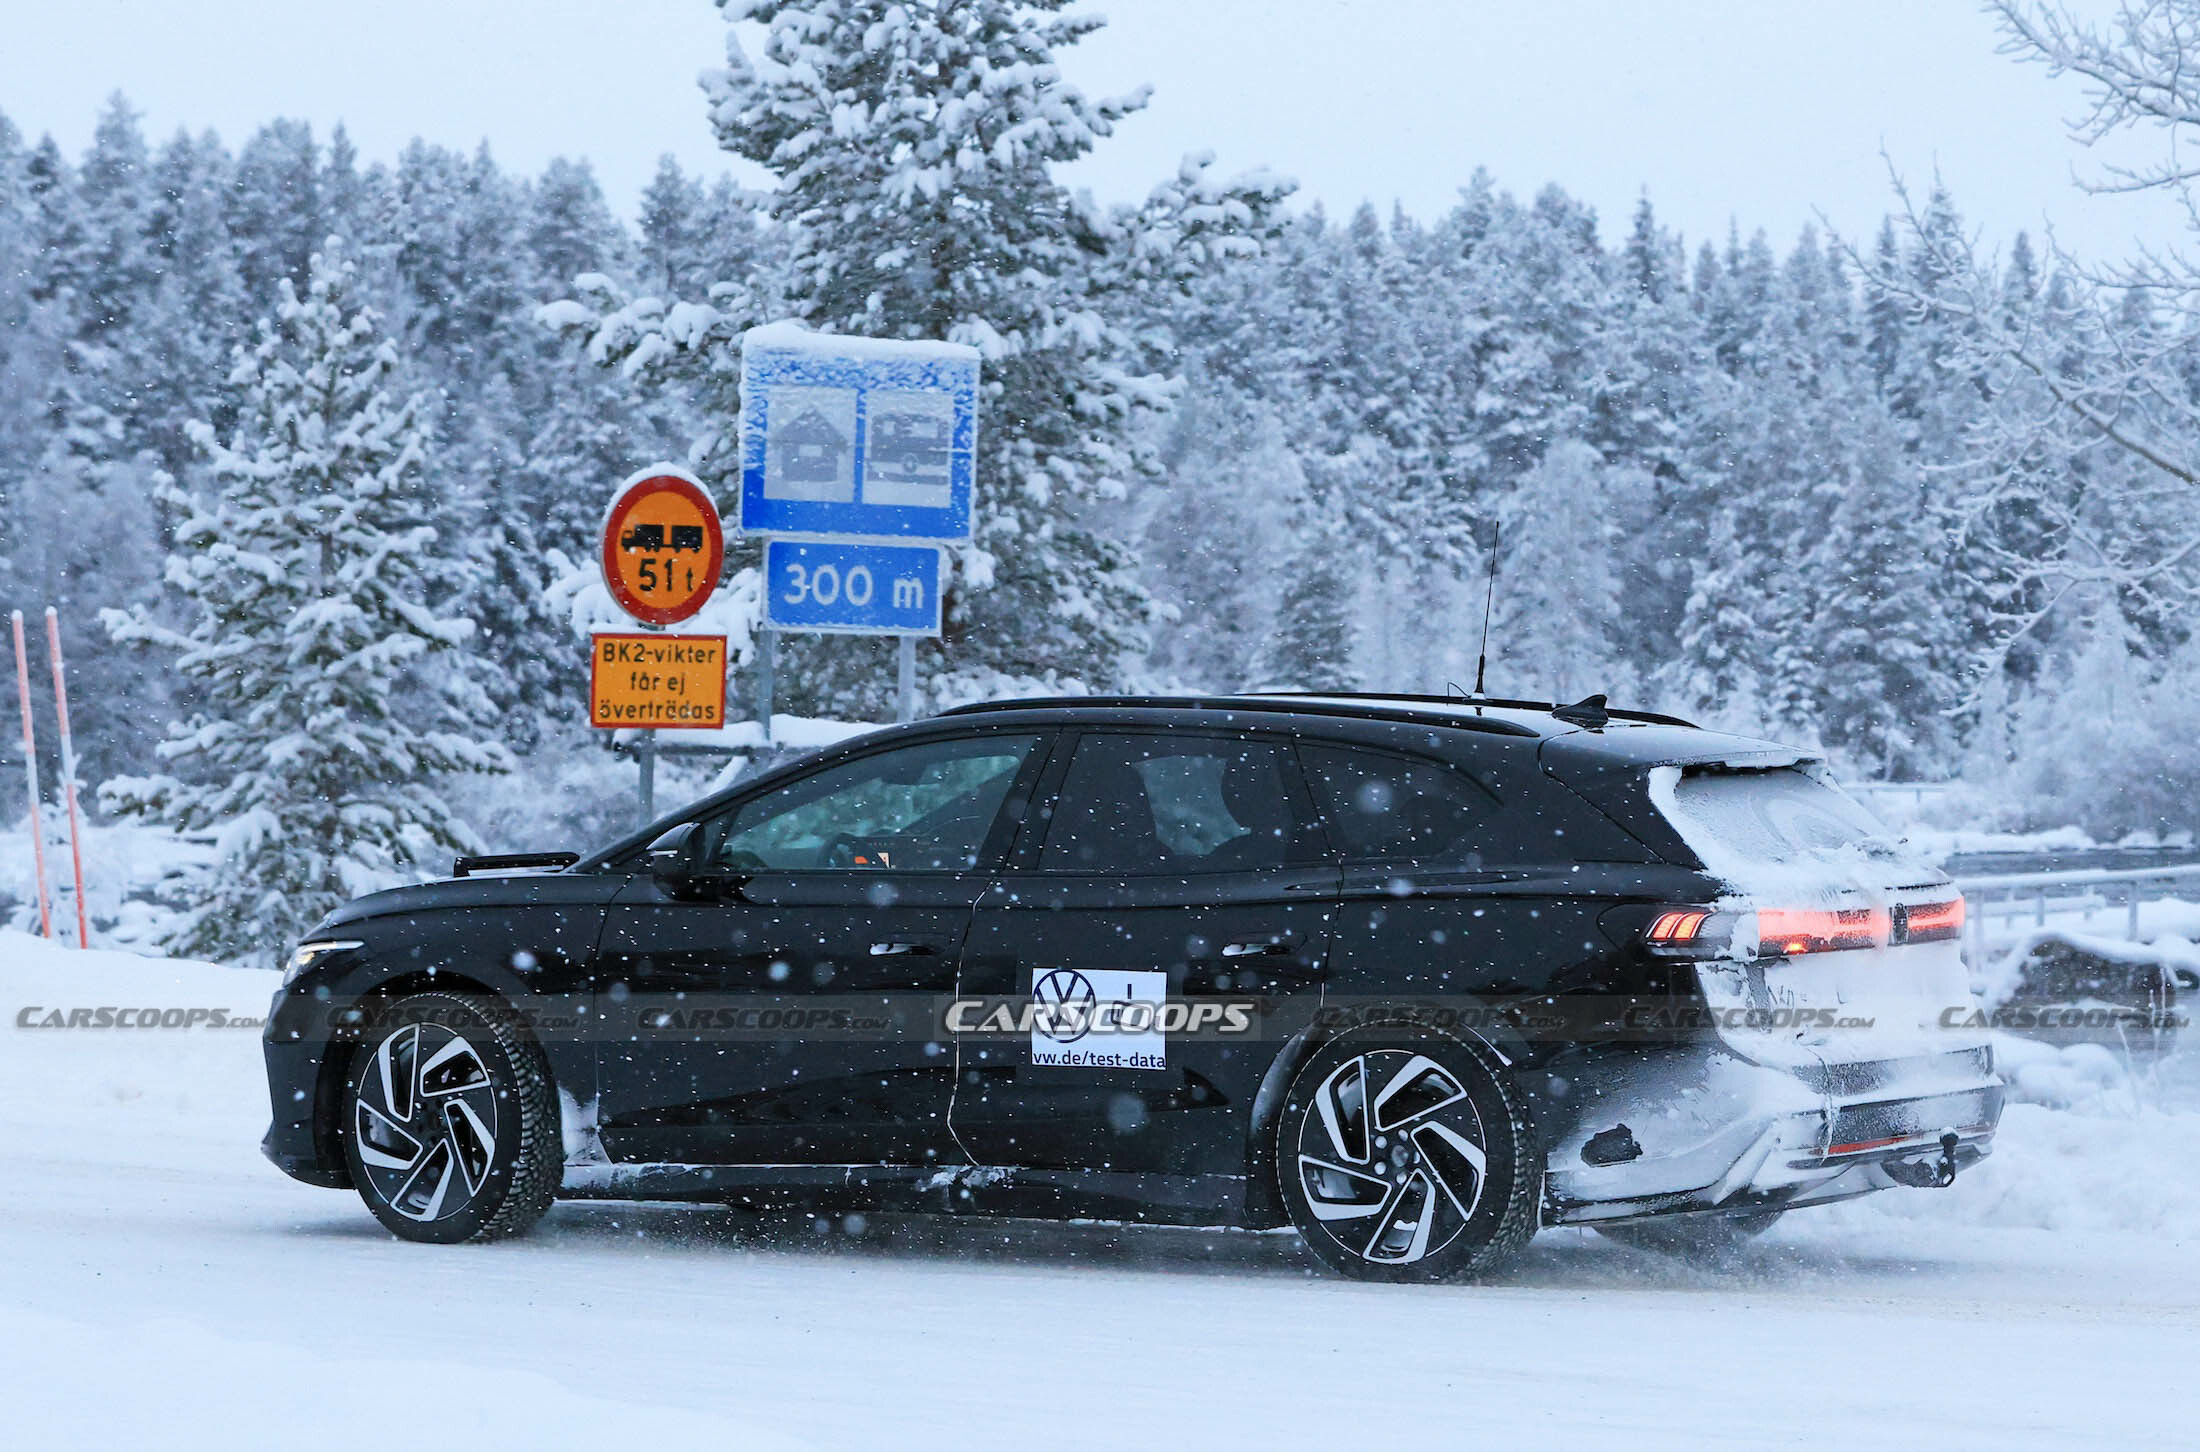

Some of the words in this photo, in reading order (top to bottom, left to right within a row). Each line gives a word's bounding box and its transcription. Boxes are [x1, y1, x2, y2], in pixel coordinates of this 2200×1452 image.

[638, 558, 673, 591] 51
[686, 568, 693, 592] t
[784, 564, 873, 606] 300
[893, 577, 924, 609] m
[603, 643, 716, 663] BK2-vikter
[631, 672, 661, 690] får
[667, 673, 685, 695] ej
[600, 699, 715, 719] överträdas
[1033, 1049, 1166, 1068] vw.de/test-data
